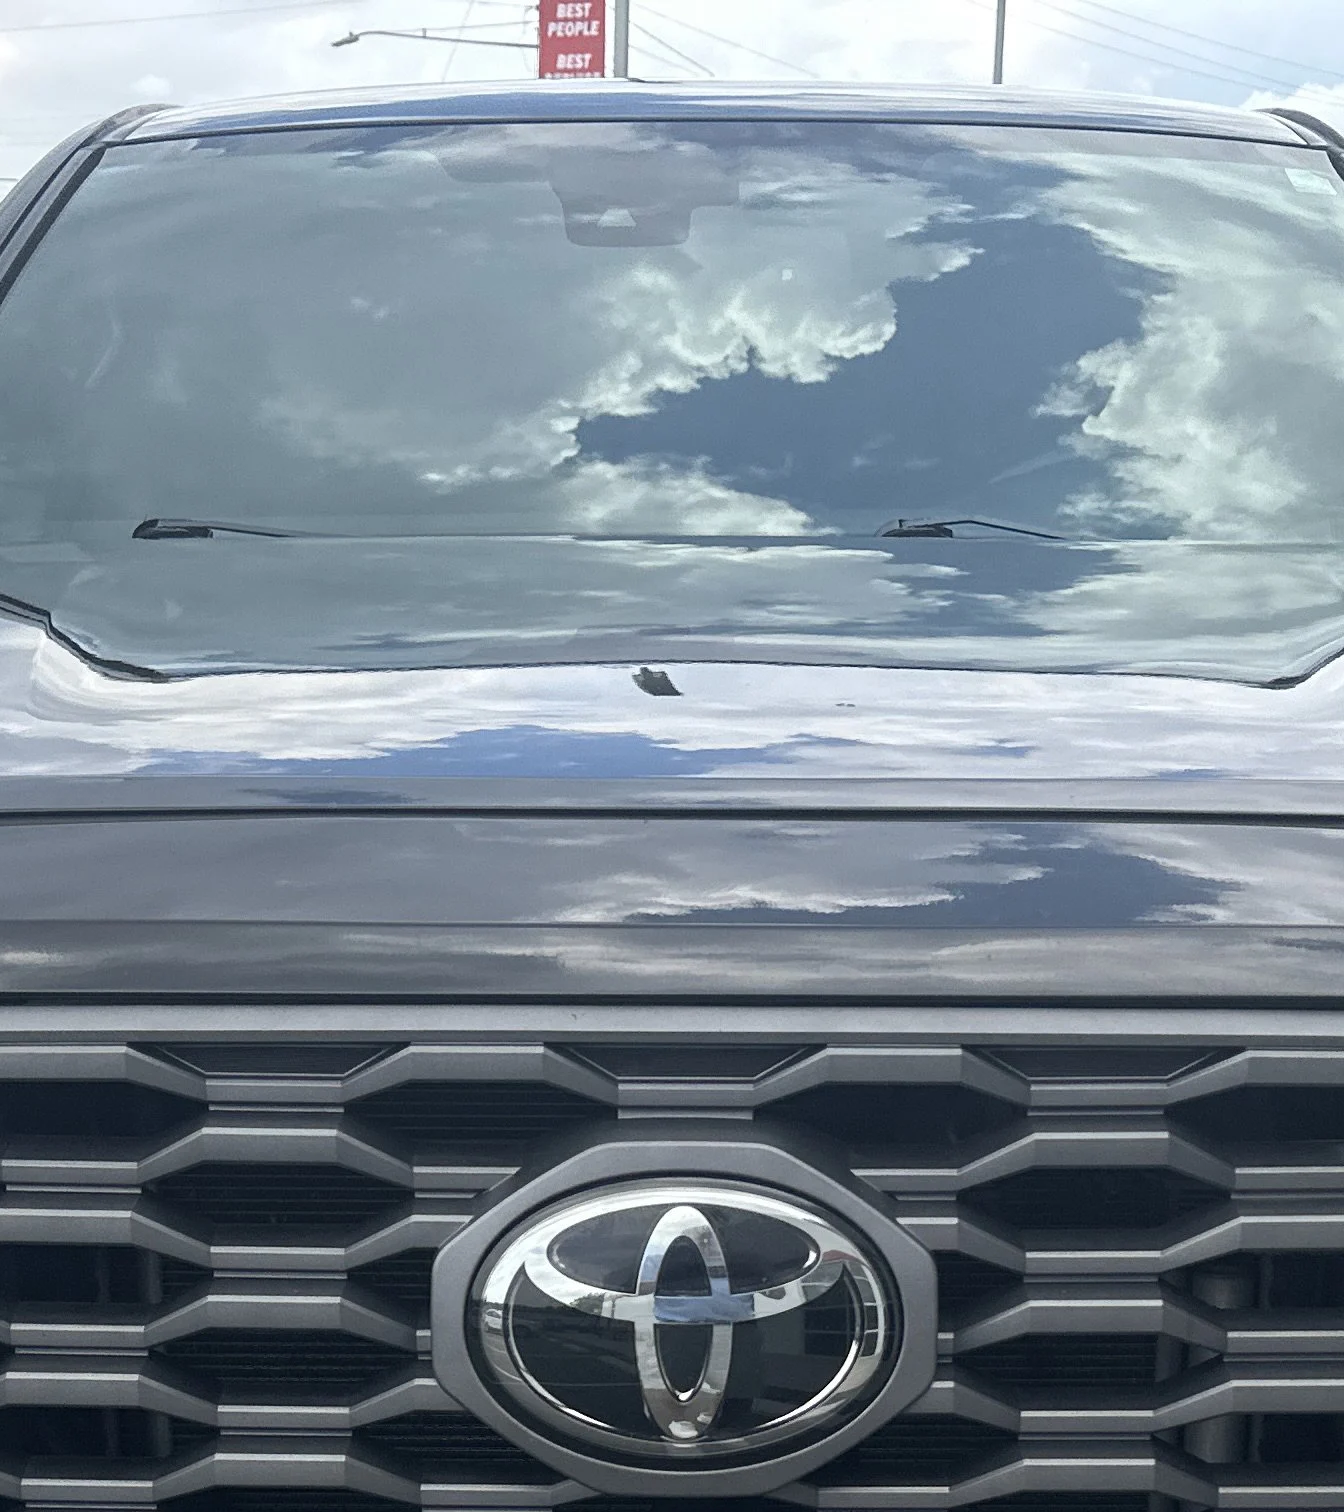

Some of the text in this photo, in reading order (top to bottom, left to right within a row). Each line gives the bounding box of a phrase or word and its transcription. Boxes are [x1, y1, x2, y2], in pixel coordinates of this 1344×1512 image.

[556, 3, 592, 18] BEST
[547, 20, 600, 37] PEOPLE
[556, 53, 592, 69] BEST
